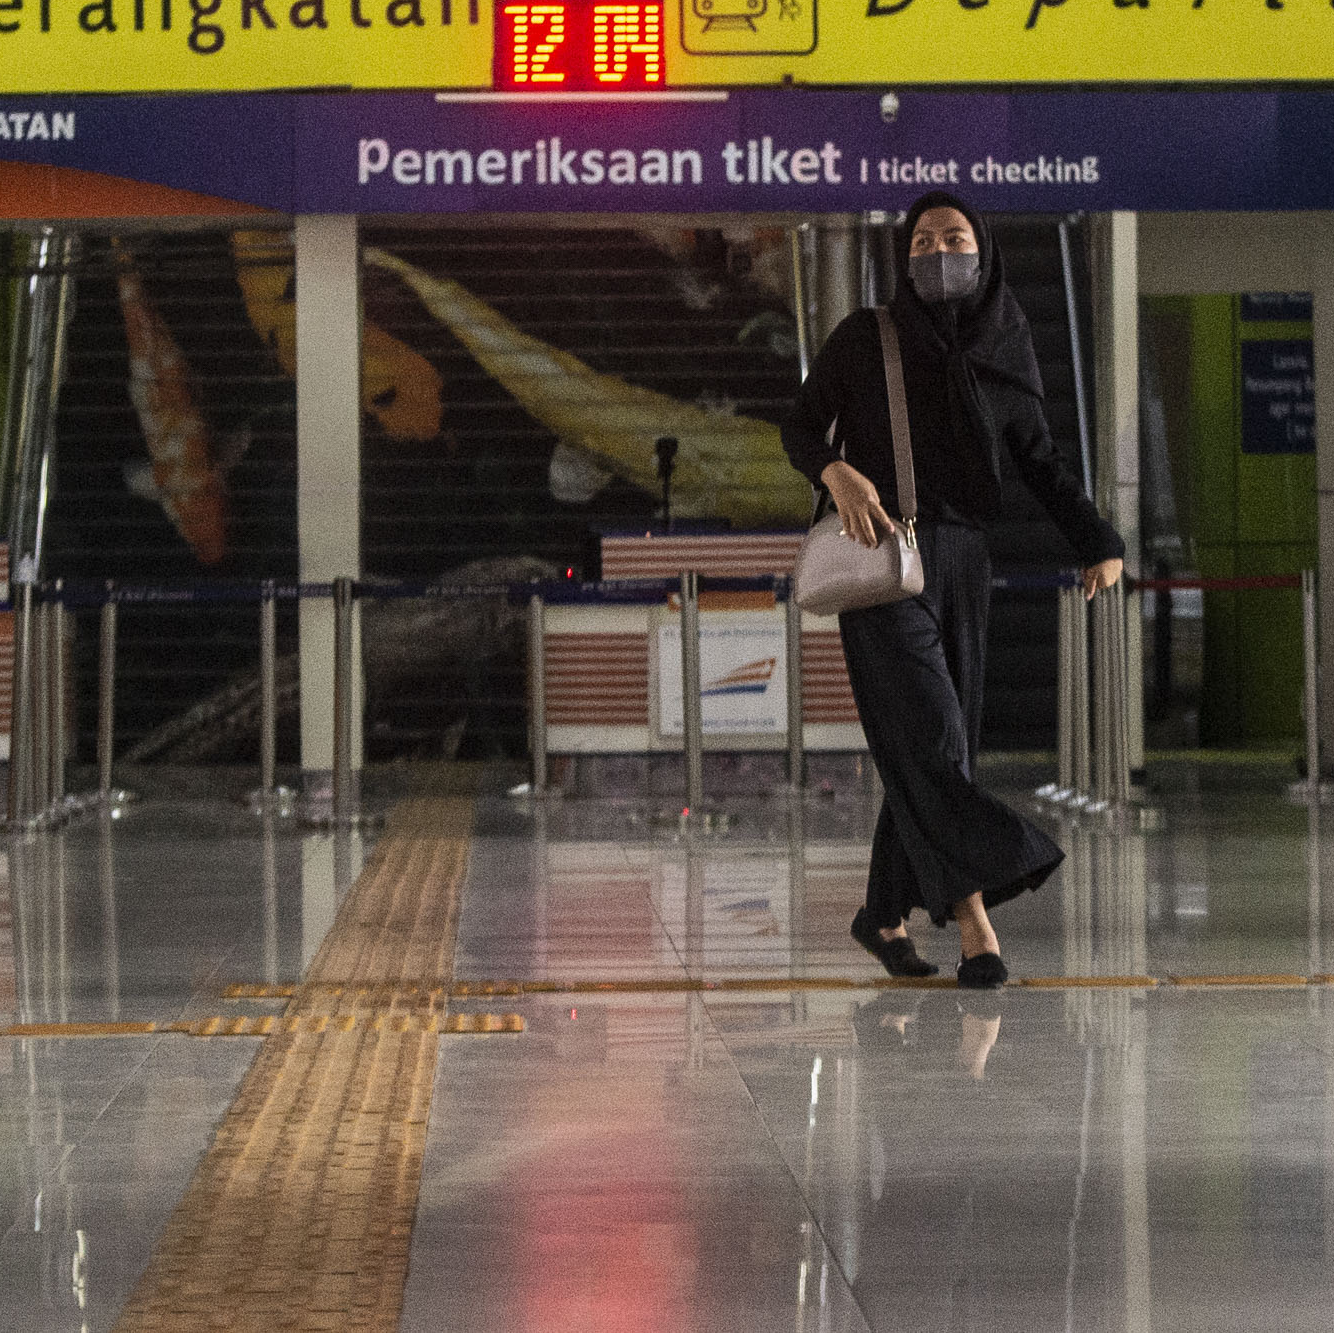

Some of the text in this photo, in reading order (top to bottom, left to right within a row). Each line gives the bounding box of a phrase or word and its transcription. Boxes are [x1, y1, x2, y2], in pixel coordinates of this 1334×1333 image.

[356, 137, 1099, 185] Pemeriksaan tiket ticket checking
